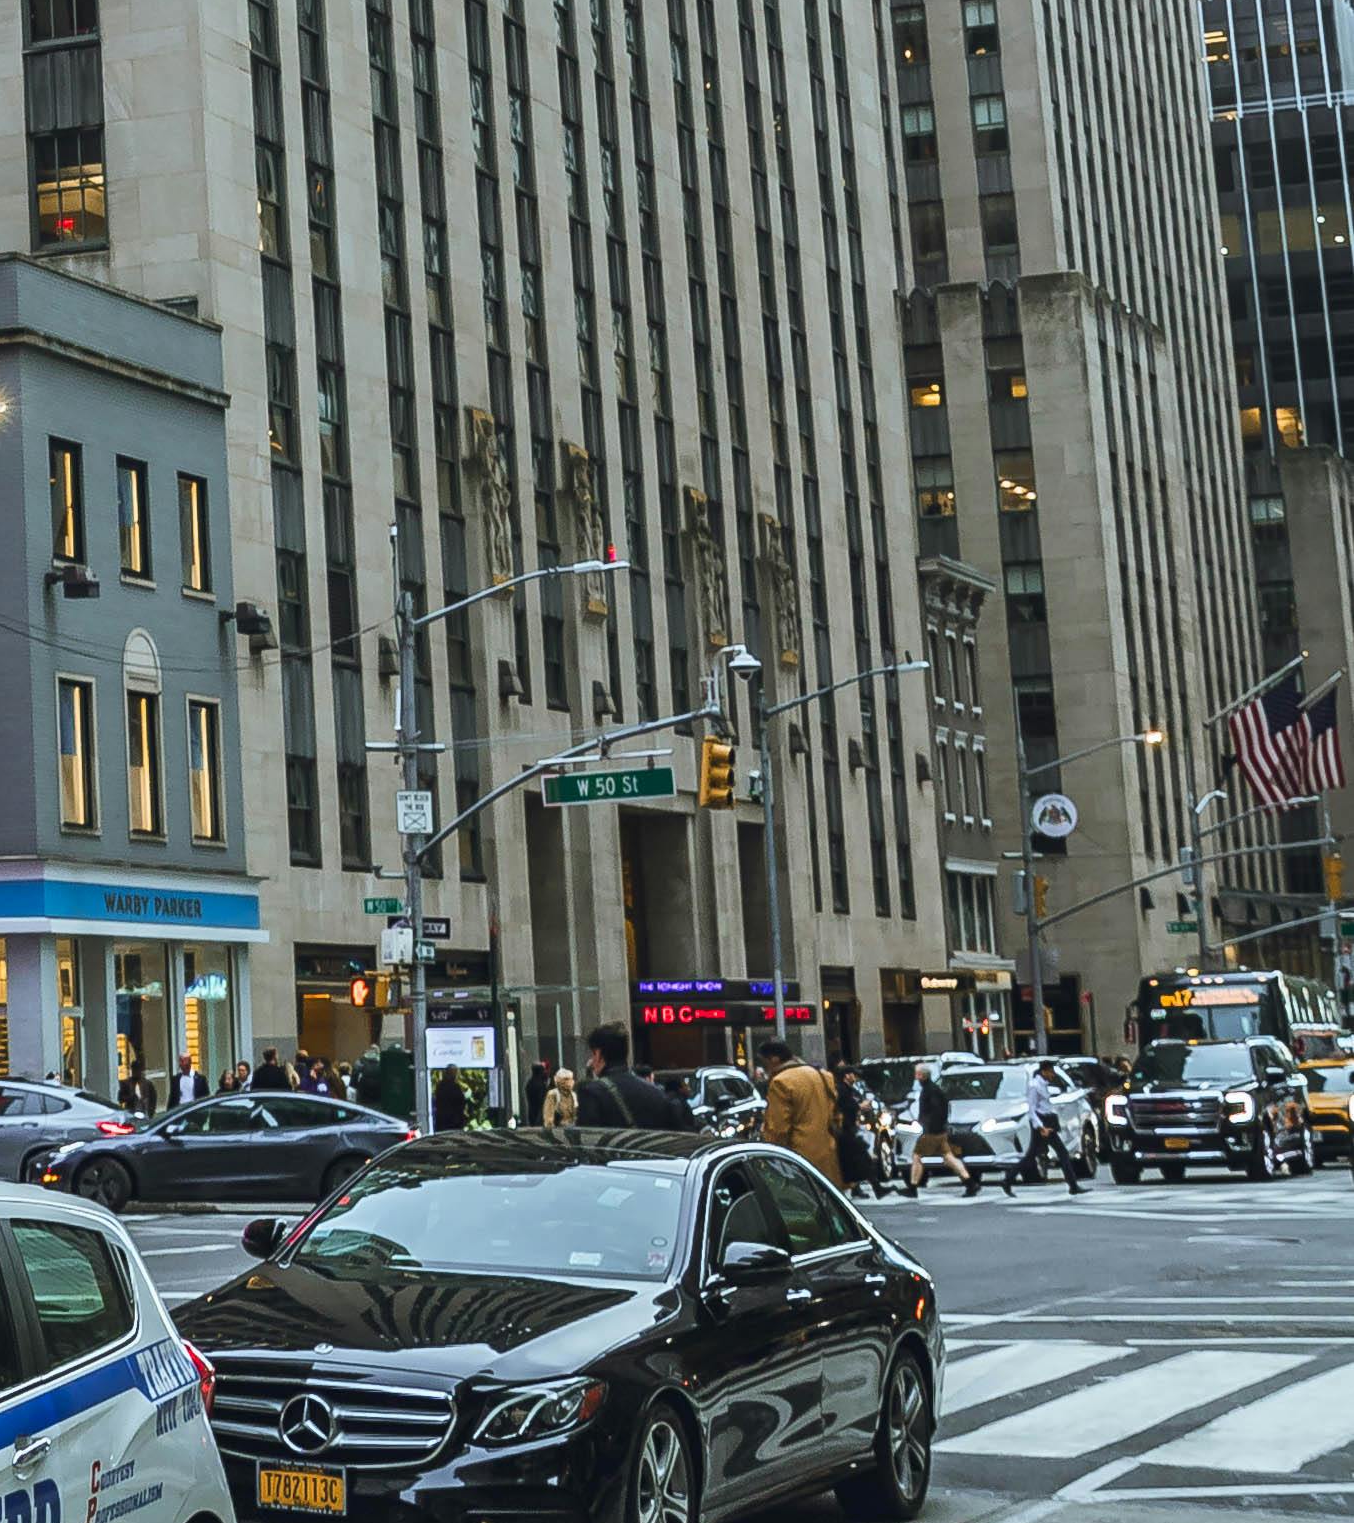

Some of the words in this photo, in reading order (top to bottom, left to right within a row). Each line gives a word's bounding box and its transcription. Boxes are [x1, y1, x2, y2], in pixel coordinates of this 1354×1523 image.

[577, 778, 589, 798] W
[595, 776, 616, 797] 50
[622, 774, 639, 794] St
[104, 892, 149, 916] WARBY
[155, 897, 203, 919] PARKER
[644, 1006, 693, 1024] NBC
[263, 1471, 339, 1505] T782113C
